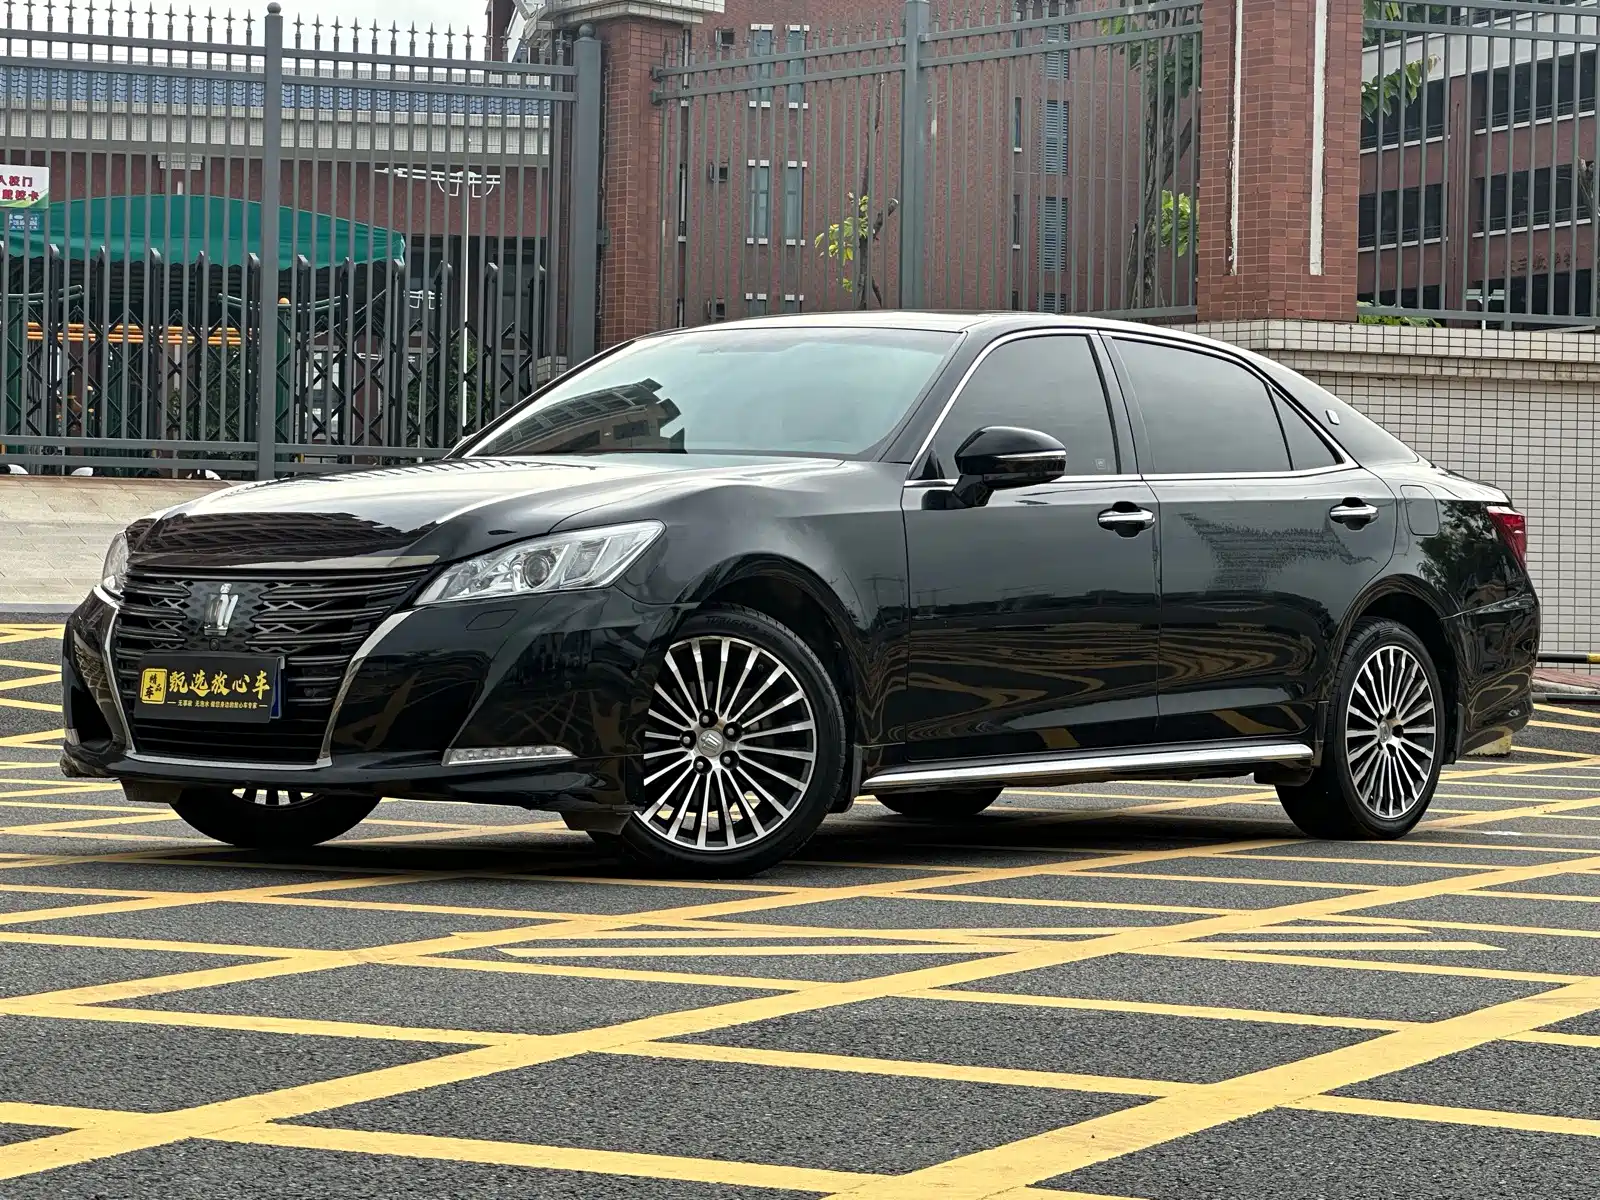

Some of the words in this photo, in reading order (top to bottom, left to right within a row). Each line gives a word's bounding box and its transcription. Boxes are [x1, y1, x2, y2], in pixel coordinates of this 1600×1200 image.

[169, 669, 270, 700] 甄选放心车
